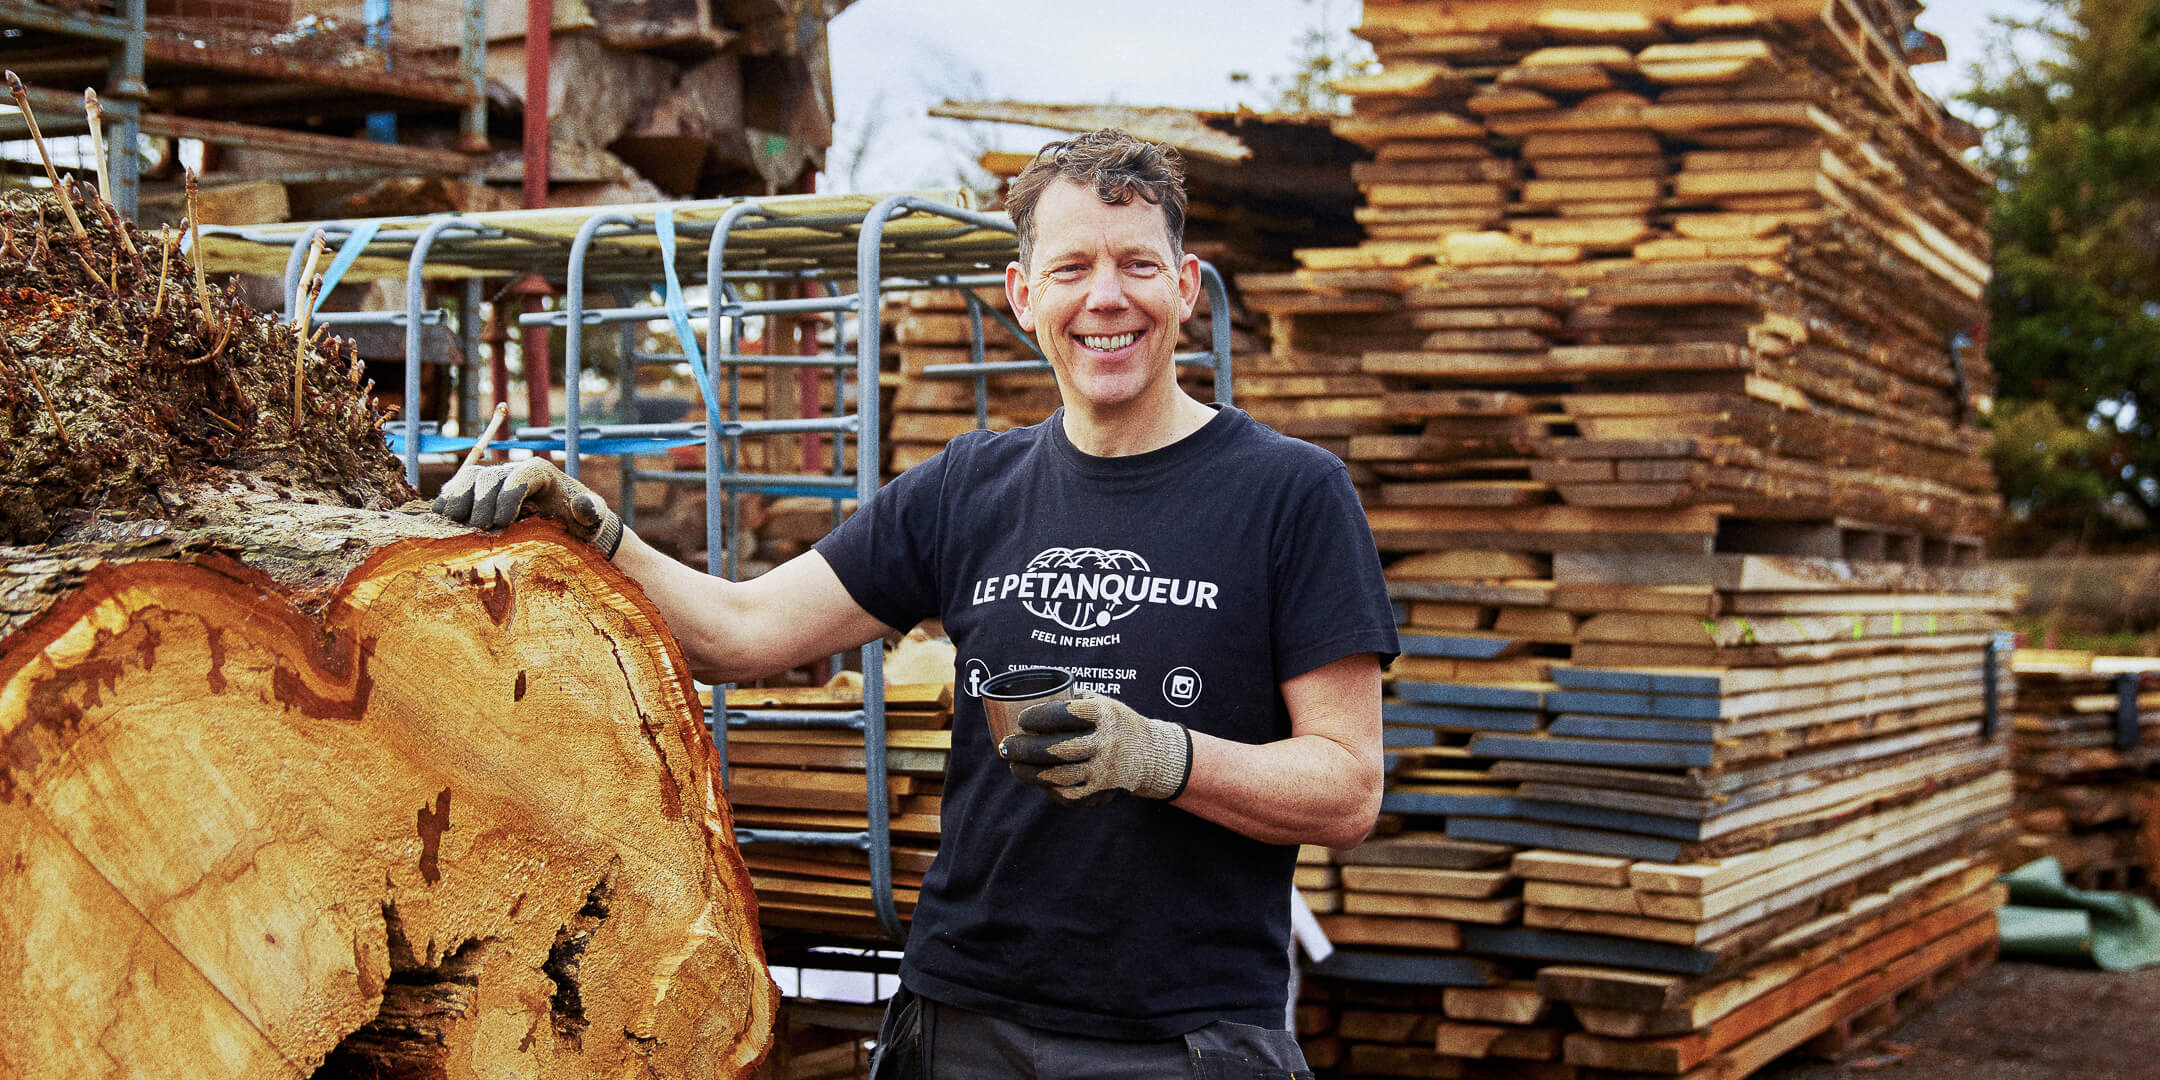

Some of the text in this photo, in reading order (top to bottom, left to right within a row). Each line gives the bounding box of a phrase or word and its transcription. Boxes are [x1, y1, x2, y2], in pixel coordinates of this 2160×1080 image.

[972, 567, 1219, 610] LE PÉTANQUEUR
[1031, 629, 1120, 648] FEEL IN FRENCH
[1071, 666, 1114, 680] PARTIES
[1115, 668, 1137, 680] SUR
